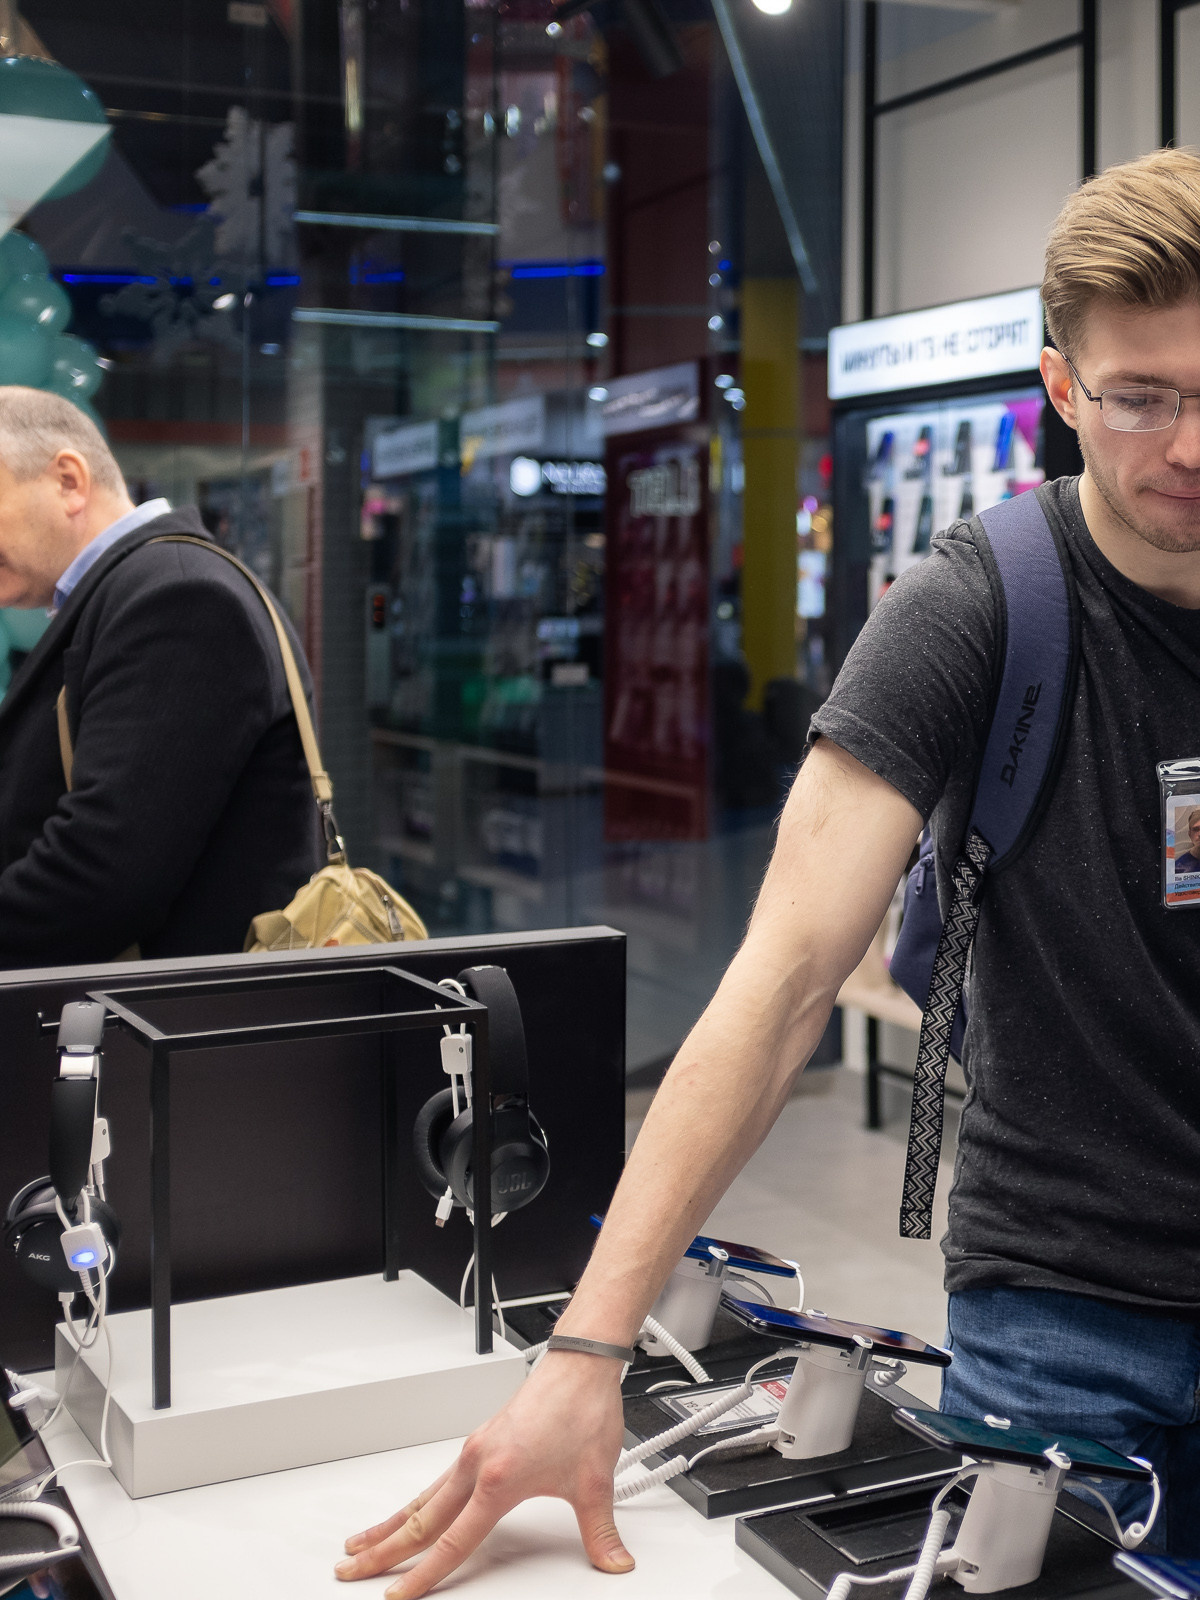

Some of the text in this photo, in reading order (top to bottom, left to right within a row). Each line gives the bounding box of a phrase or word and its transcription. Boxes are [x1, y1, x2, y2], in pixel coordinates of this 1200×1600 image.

[1000, 682, 1043, 788] DAKINE
[498, 1172, 532, 1194] JBL
[28, 1252, 51, 1262] AKG
